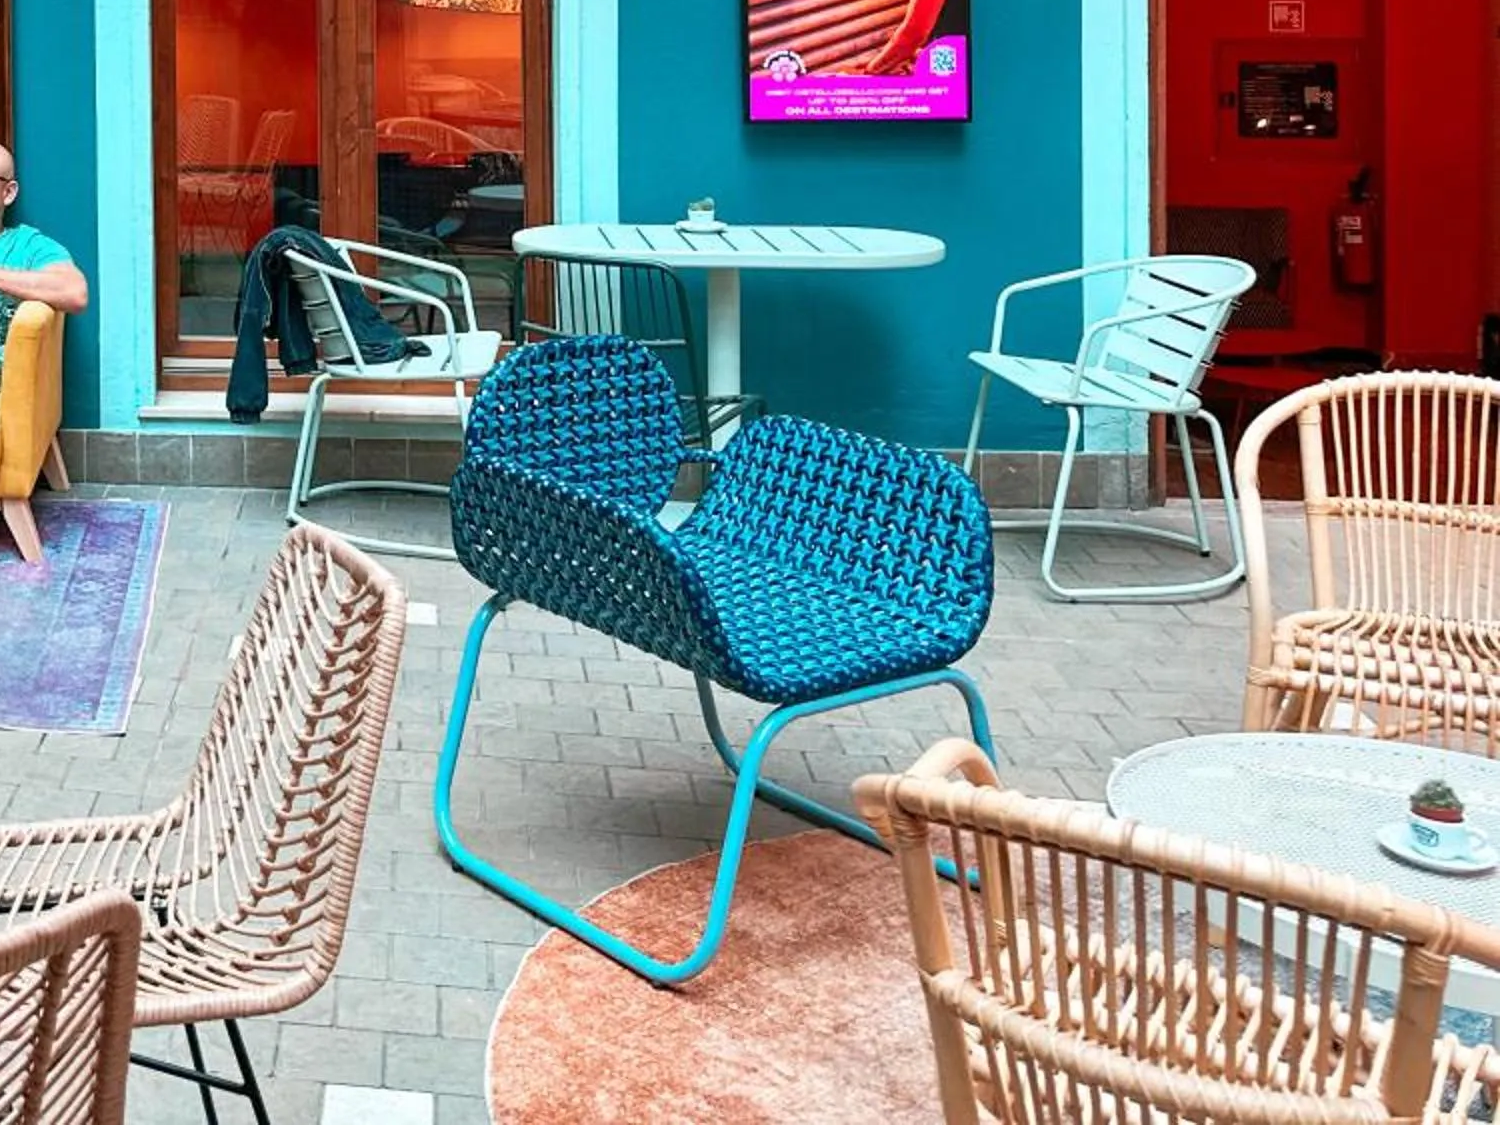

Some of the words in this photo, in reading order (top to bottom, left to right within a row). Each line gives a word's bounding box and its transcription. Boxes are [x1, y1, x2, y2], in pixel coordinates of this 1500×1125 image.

[785, 106, 805, 115] ON
[807, 106, 832, 115] ALL
[833, 105, 931, 115] DESTINATIONS
